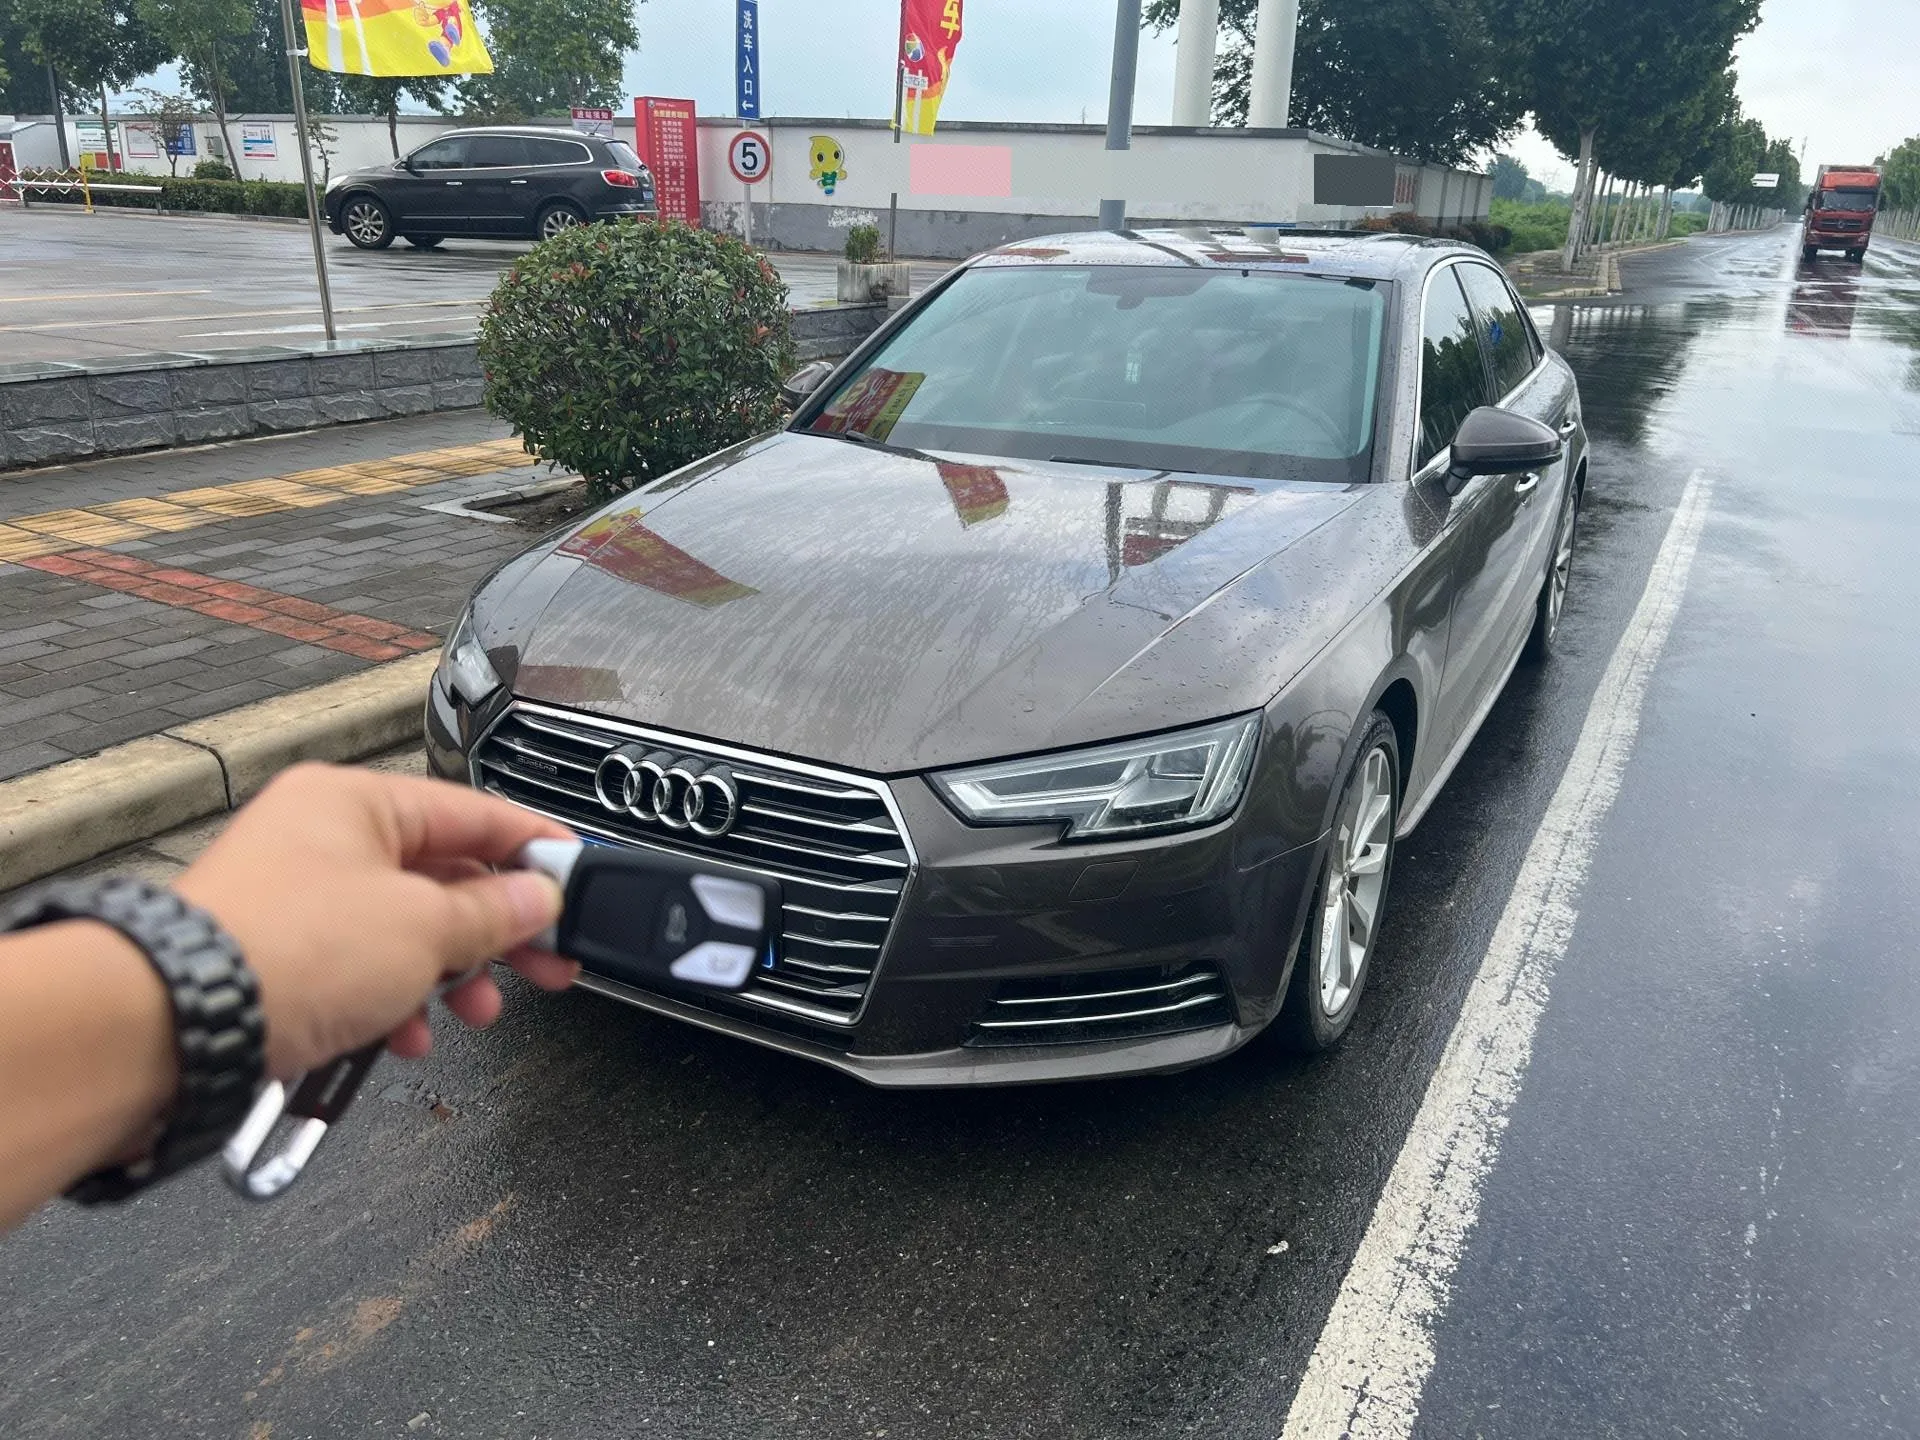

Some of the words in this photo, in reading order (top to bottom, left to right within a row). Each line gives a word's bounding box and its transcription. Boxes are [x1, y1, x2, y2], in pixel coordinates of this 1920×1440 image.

[743, 10, 753, 96] 洗车入口
[741, 142, 758, 171] 5
